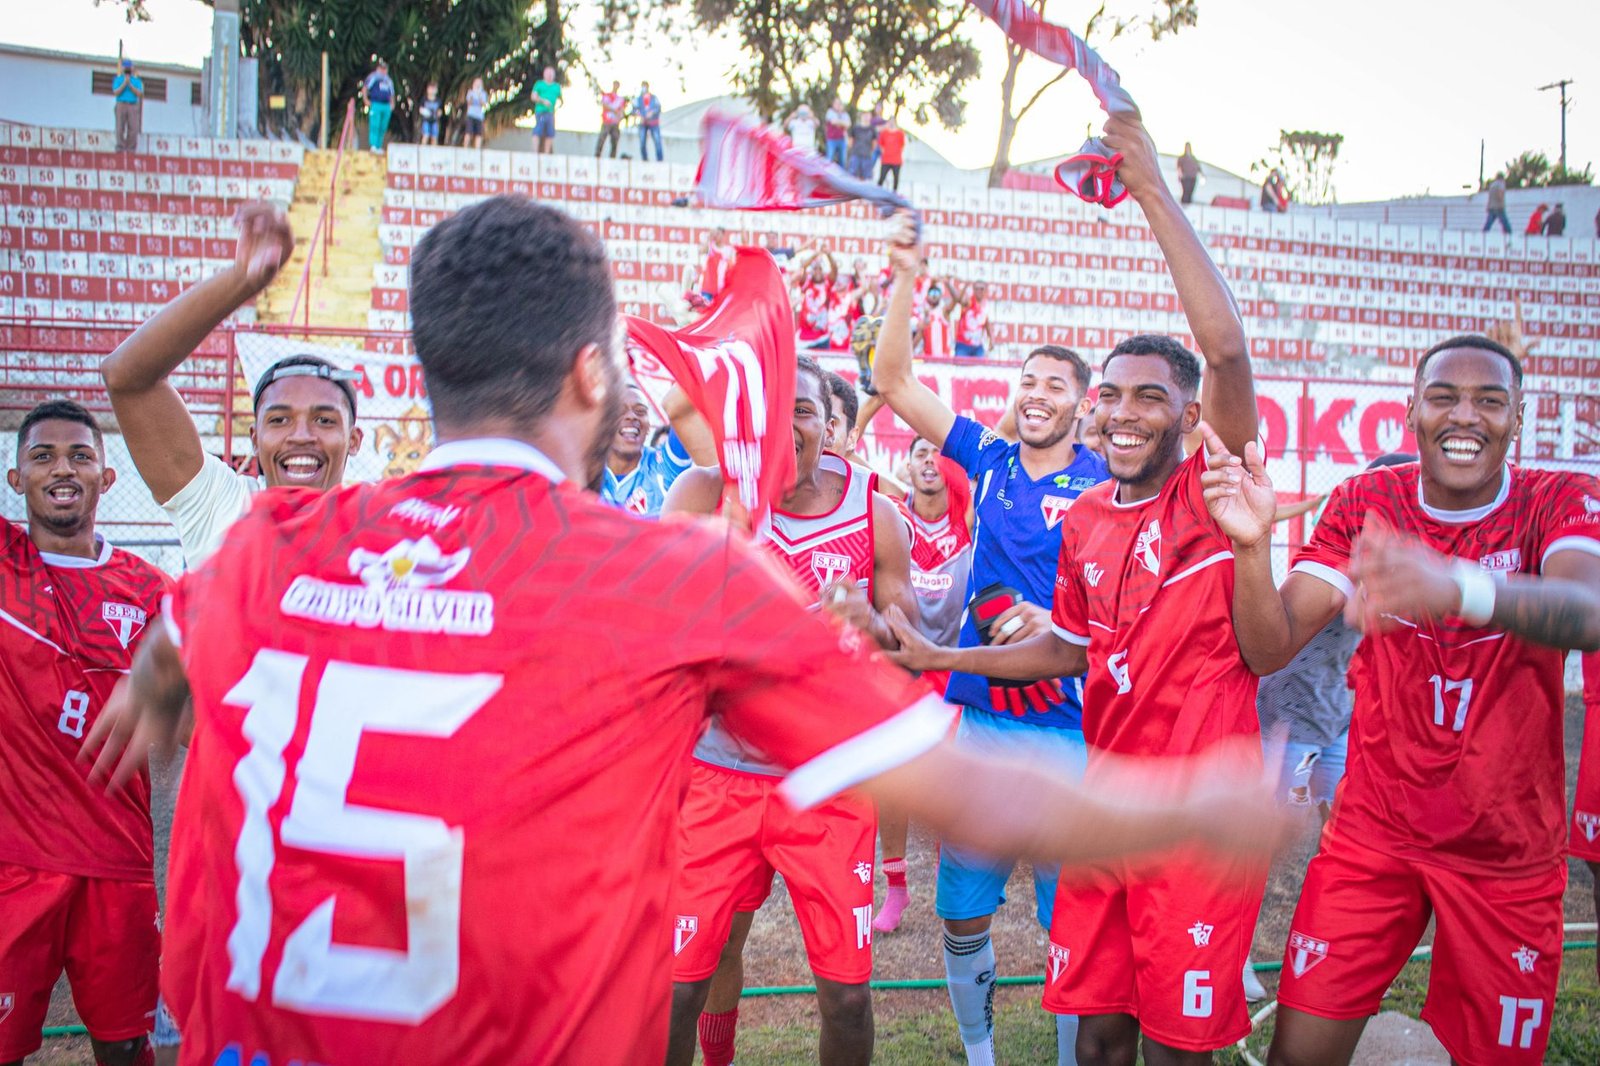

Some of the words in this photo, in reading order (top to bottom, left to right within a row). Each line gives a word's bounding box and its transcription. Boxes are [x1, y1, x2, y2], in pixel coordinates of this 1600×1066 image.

[1107, 648, 1132, 695] 6
[58, 689, 90, 739] 8
[1429, 674, 1473, 732] 17
[222, 647, 505, 1027] 15
[853, 904, 872, 950] 14
[1182, 970, 1213, 1018] 6
[1498, 995, 1543, 1049] 17
